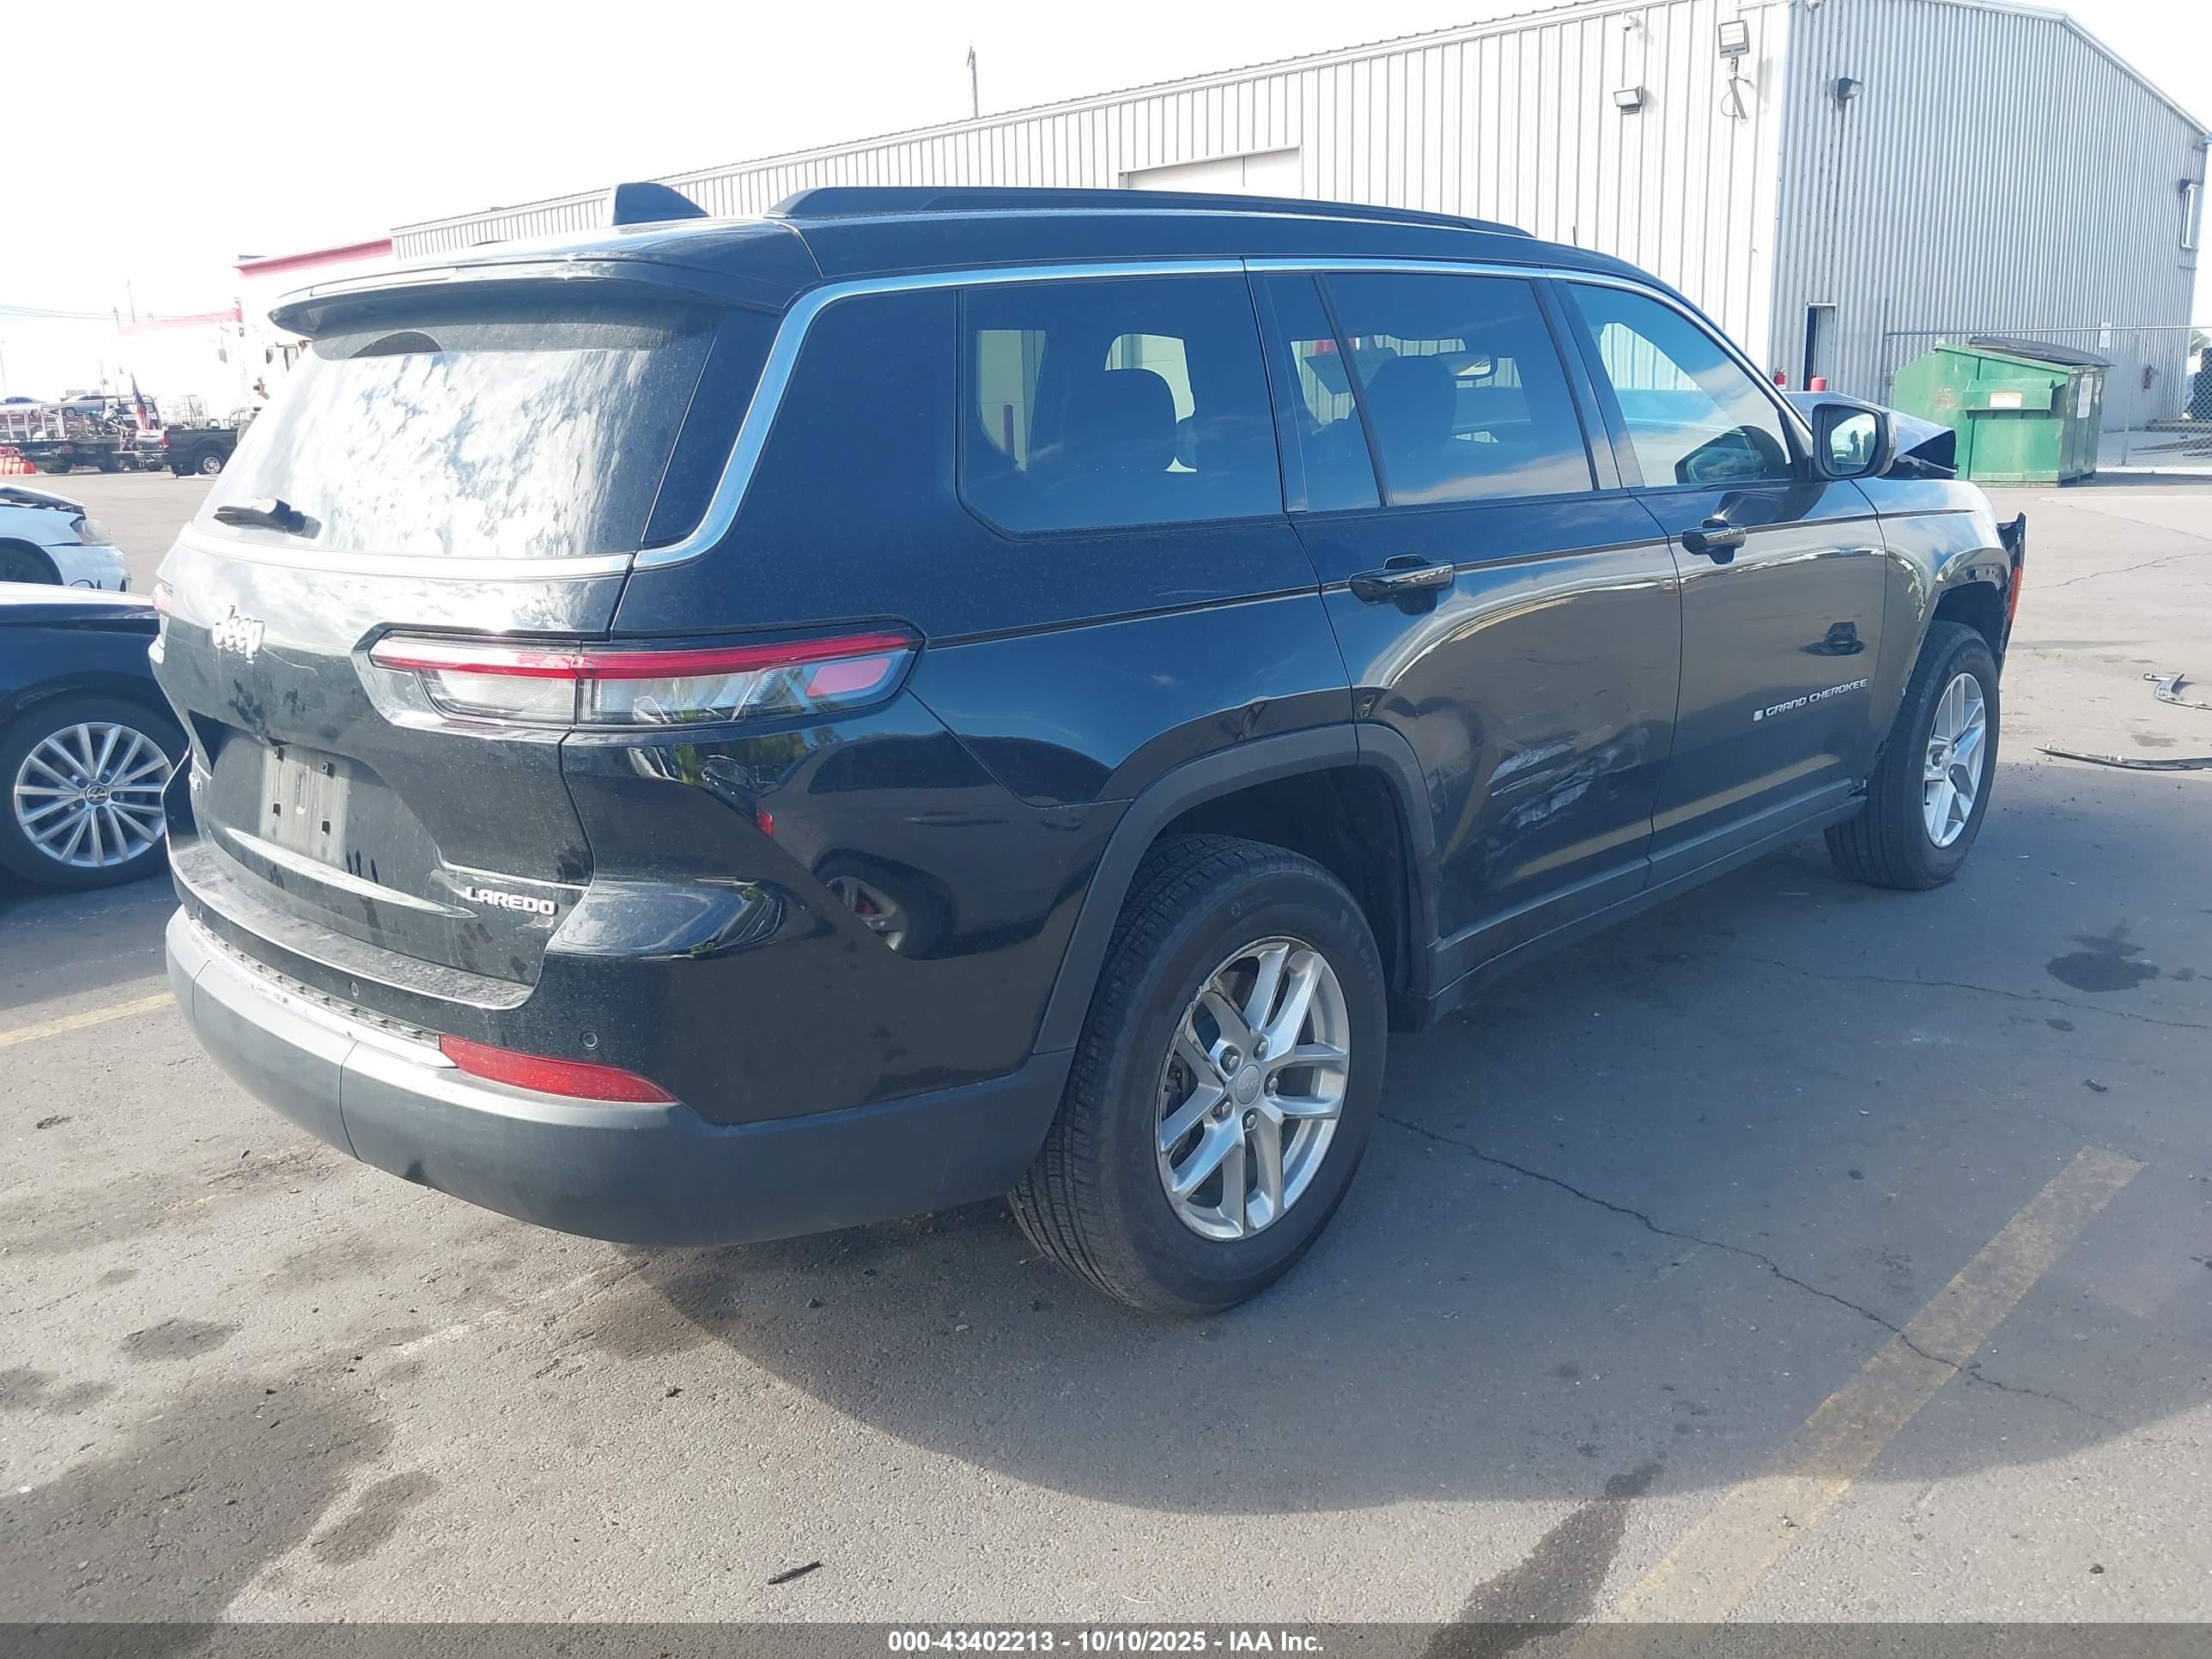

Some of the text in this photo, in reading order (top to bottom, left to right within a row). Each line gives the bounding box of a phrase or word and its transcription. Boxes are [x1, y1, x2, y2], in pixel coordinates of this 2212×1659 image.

[212, 605, 265, 664] Jeep
[1765, 678, 1869, 717] GRAND CHEROKEE
[465, 885, 557, 915] LAREDO
